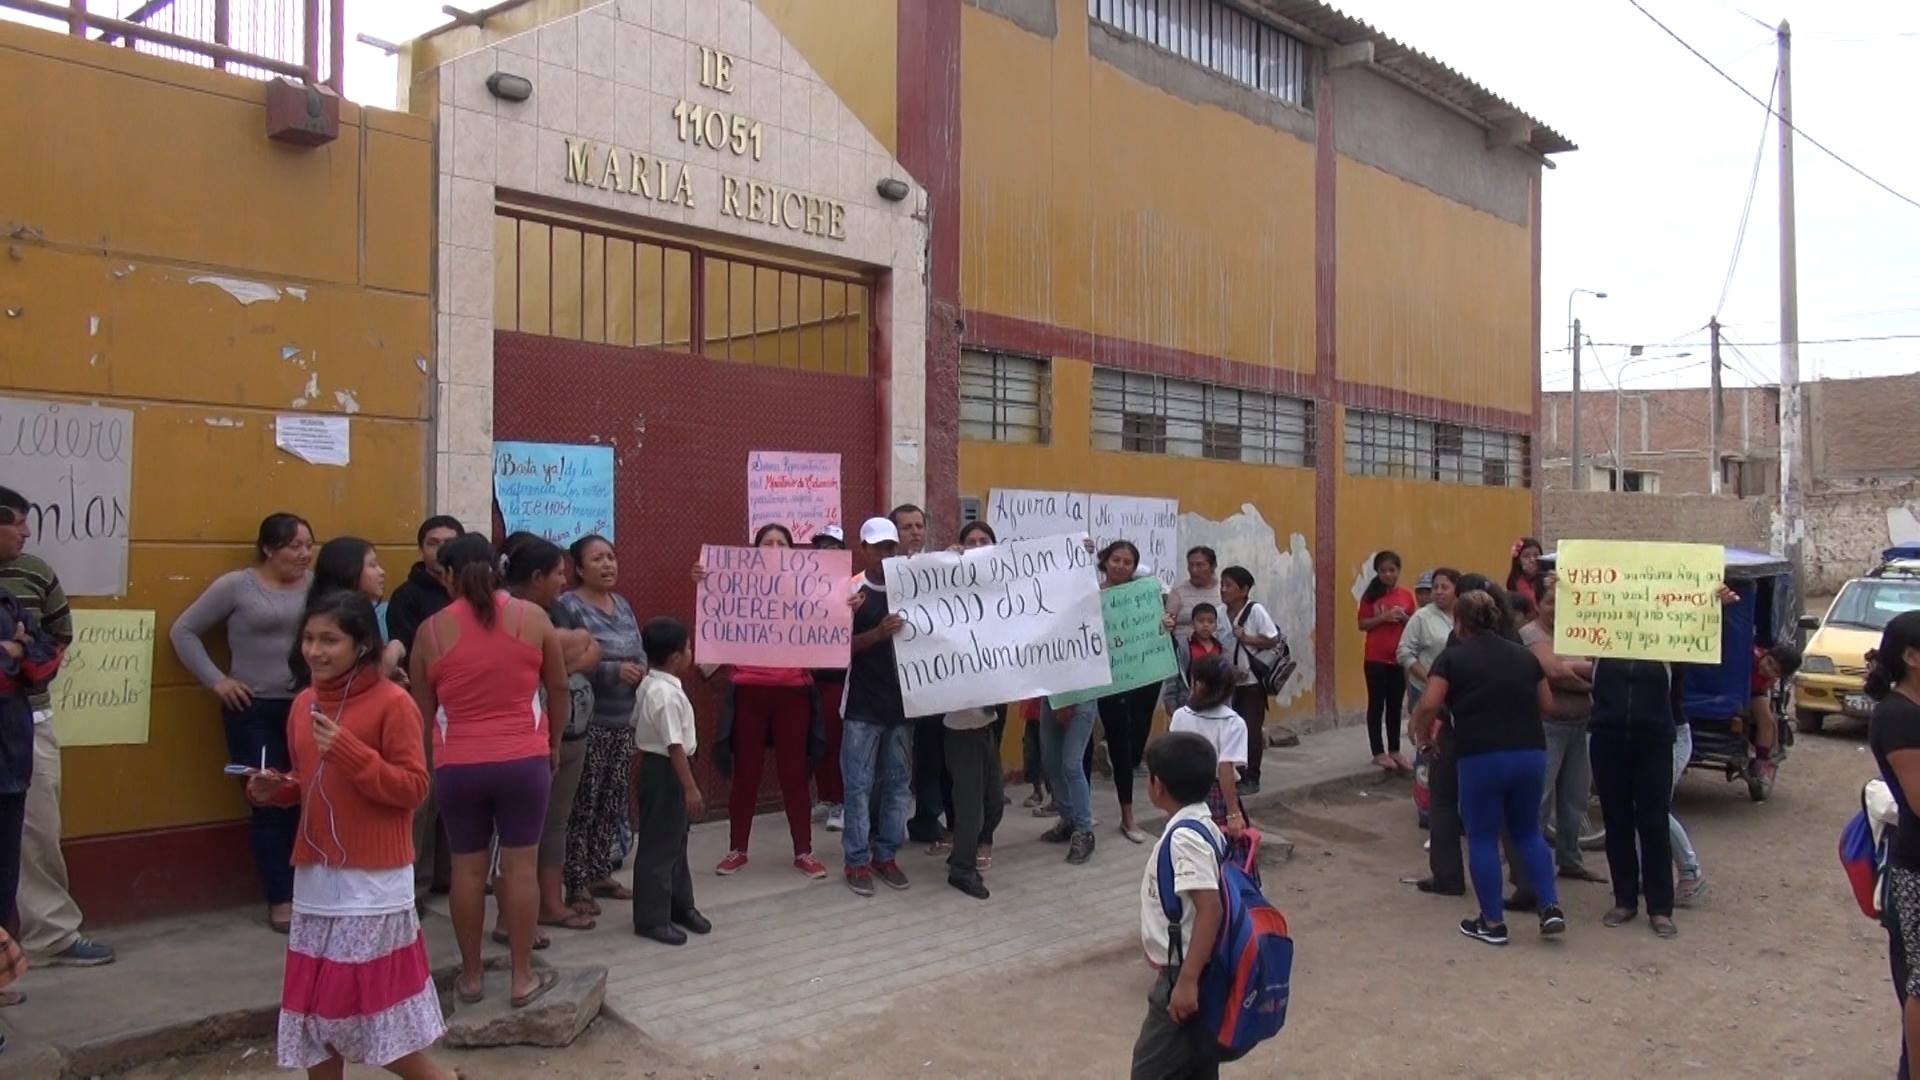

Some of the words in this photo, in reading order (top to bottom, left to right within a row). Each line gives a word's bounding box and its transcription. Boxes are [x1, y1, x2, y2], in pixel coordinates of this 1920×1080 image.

[700, 46, 735, 95] IE
[672, 96, 764, 163] 11051
[564, 134, 696, 209] MARIA
[720, 174, 848, 241] REICHE
[0, 404, 124, 463] uiere
[28, 464, 129, 545] ntas
[996, 491, 1057, 529] Afuera
[1065, 492, 1084, 521] la
[780, 549, 820, 573] LOS
[893, 558, 980, 600] Donde
[702, 595, 830, 623] QUEREMOS
[996, 577, 1056, 620] del
[701, 619, 783, 645] CUENTAS
[788, 624, 851, 646] CLARAS
